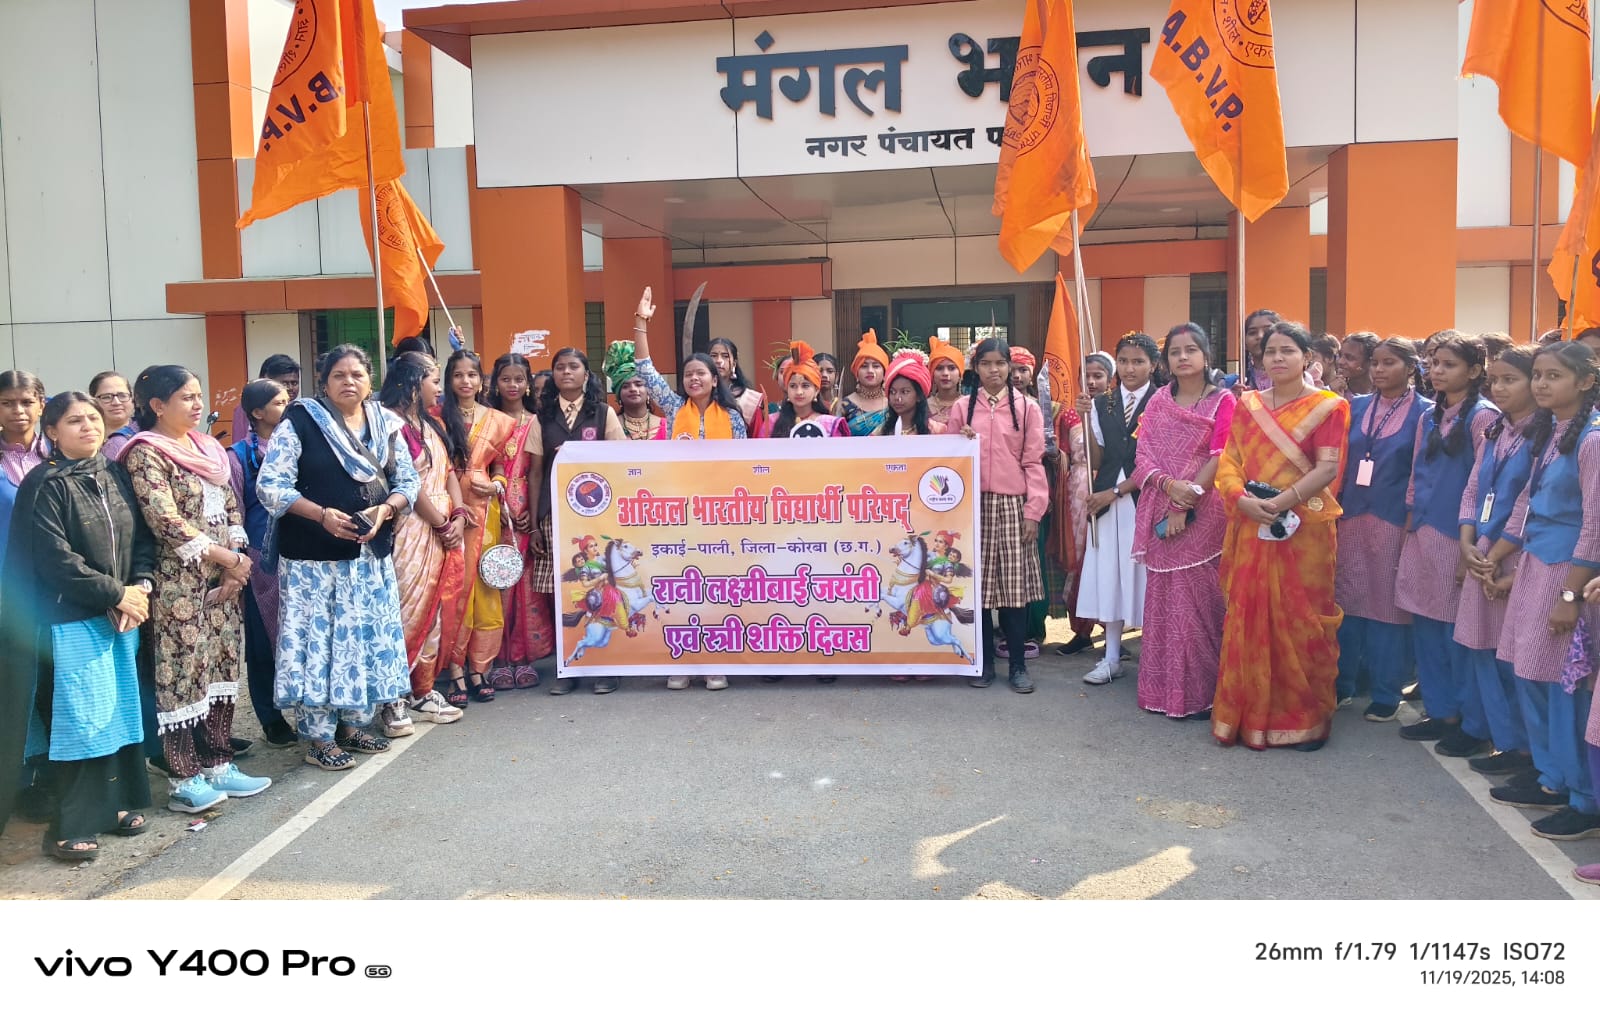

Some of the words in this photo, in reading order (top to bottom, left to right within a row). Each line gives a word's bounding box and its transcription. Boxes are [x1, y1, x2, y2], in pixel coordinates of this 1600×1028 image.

[1222, 16, 1241, 43] शील
[716, 30, 908, 120] मंगल
[948, 27, 1150, 102] भन
[1161, 9, 1243, 132] A.B.V.P.
[805, 135, 868, 158] नगर
[878, 126, 976, 154] पंचायत
[752, 464, 770, 474] शील
[617, 488, 688, 525] अखिल
[692, 485, 767, 524] भारतीय
[770, 485, 844, 523] विद्यार्थी
[845, 485, 912, 532] परिषद्
[834, 539, 883, 556] (छ.ग.)
[652, 566, 703, 604] रानी
[706, 564, 811, 606] लक्ष्मीबाई
[811, 563, 882, 603] जयंती
[664, 614, 700, 659] एवं
[702, 614, 744, 653] स्त्री
[746, 613, 804, 653] शक्ति
[806, 613, 872, 655] दिवस
